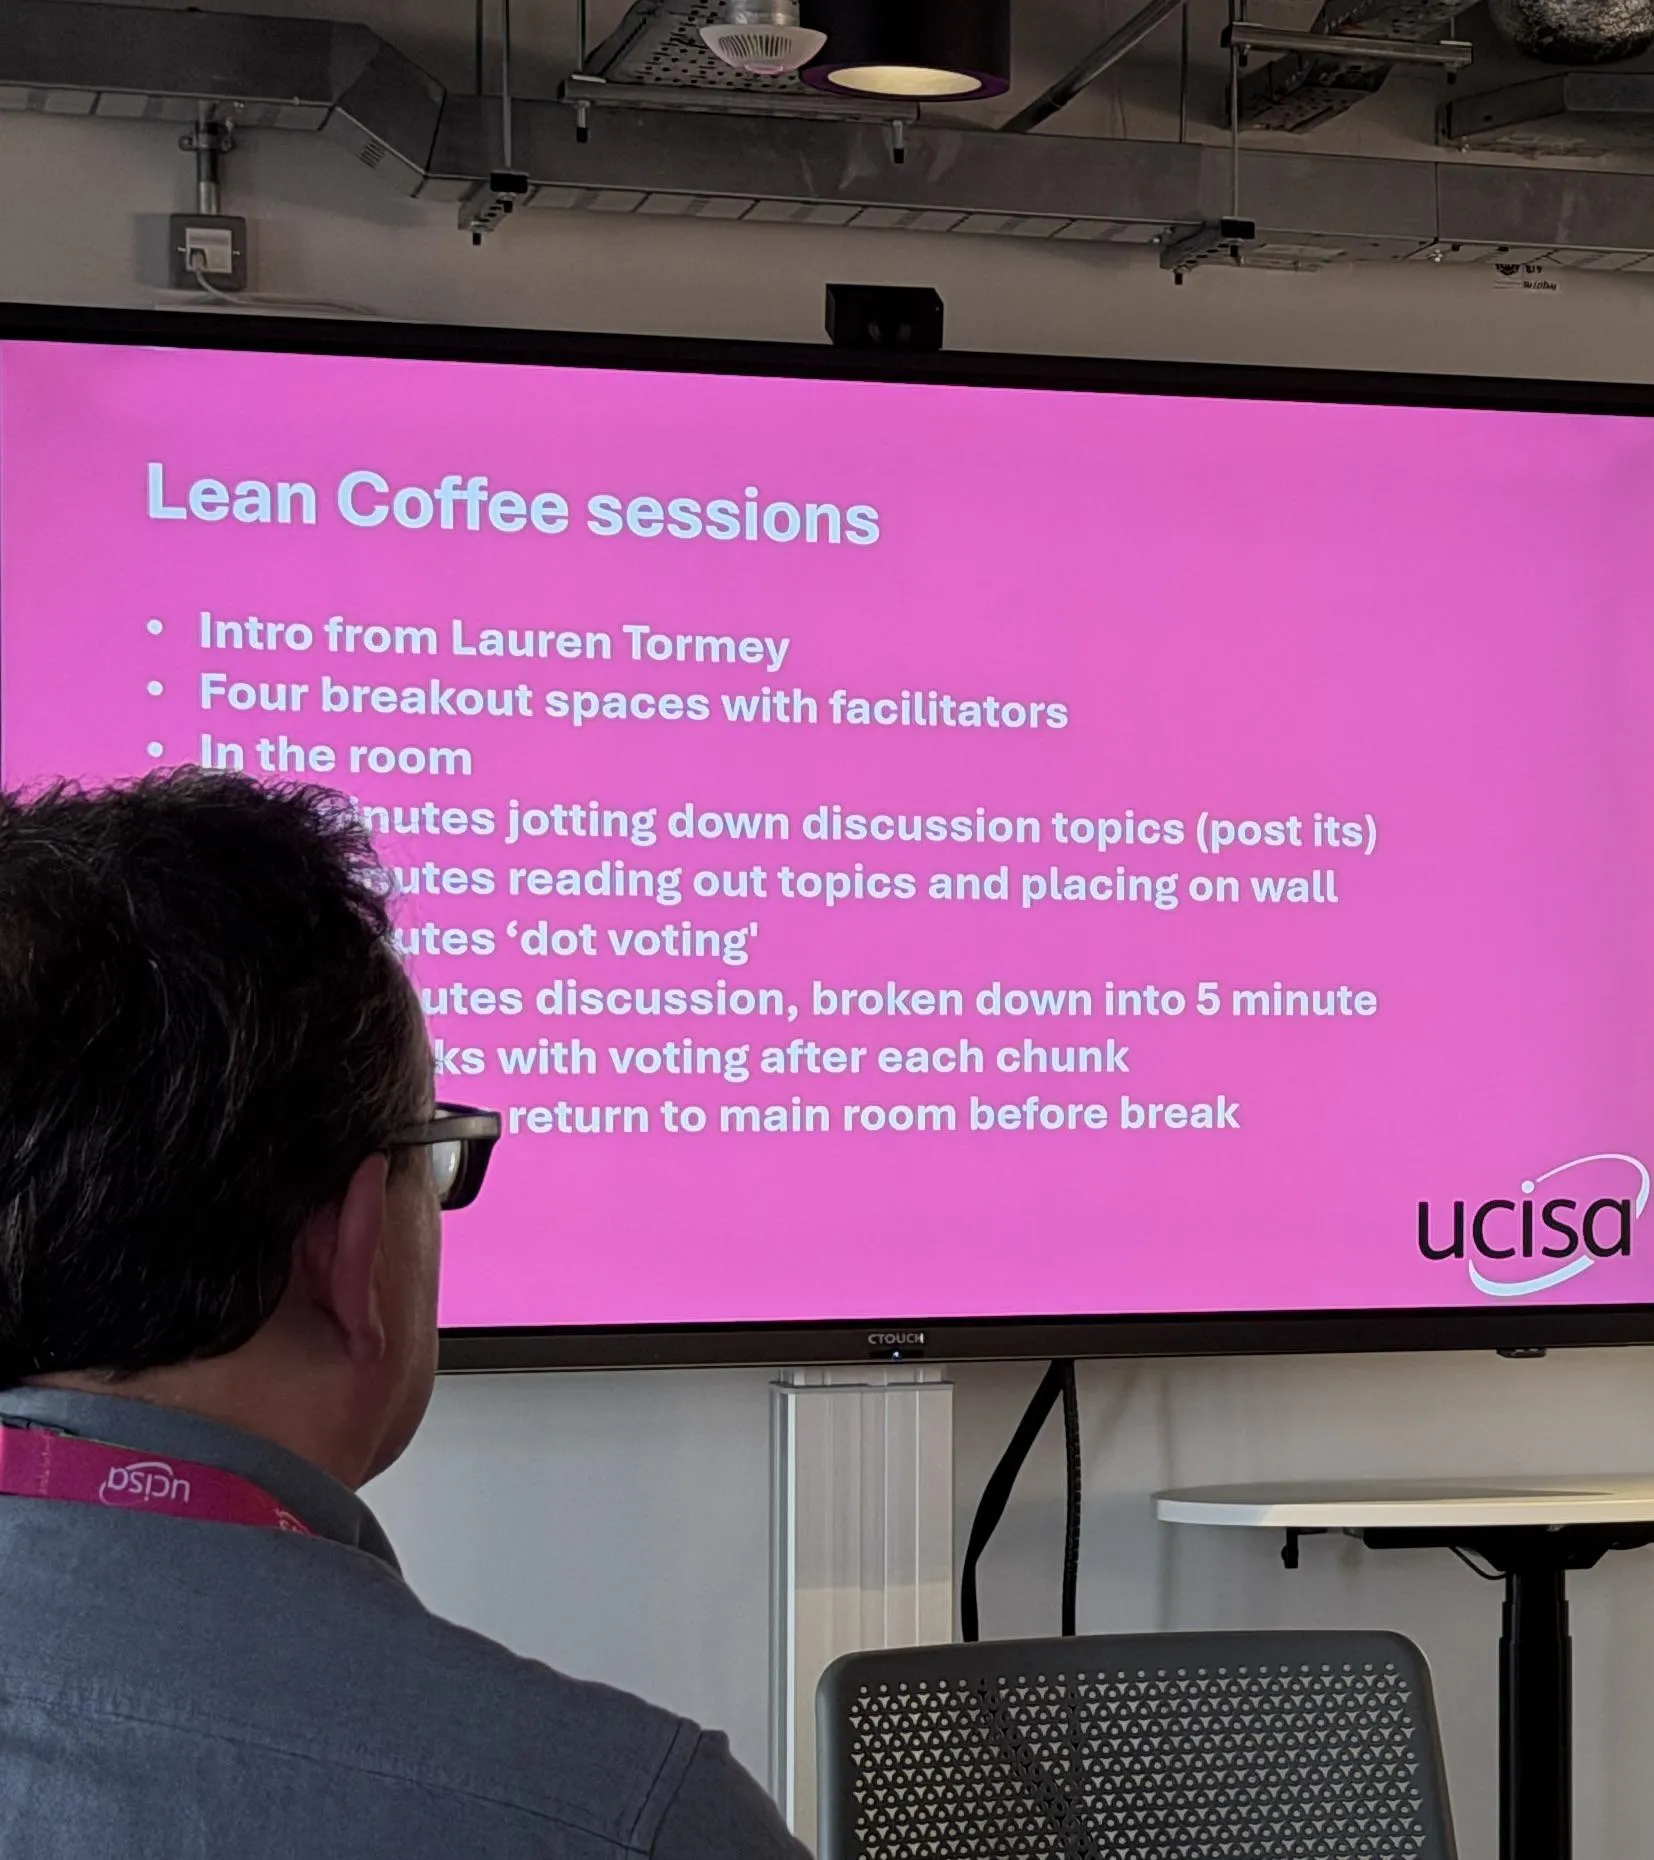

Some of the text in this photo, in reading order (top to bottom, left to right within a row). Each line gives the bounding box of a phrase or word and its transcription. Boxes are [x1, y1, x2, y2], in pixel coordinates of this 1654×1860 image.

[149, 463, 879, 544] Lean Coffee sessions
[201, 612, 789, 672] Intro from Lauren Tormey
[202, 673, 1068, 728] Four breakout spaces with facilitators
[201, 734, 471, 775] In the room
[505, 800, 656, 846] jotting
[668, 803, 788, 839] down
[803, 805, 1040, 842] discussion
[1052, 810, 1184, 852] topics
[1197, 812, 1302, 853] (post
[1314, 813, 1376, 855] its)
[394, 860, 1338, 910] utes reading out topics and placing on wall
[391, 923, 495, 955] utes
[418, 979, 1376, 1021] utes discussion, broken down into 5 minute
[497, 1038, 596, 1074] with
[609, 1038, 749, 1082] voting
[761, 1039, 867, 1073] after
[878, 1039, 983, 1072] each
[997, 1039, 1129, 1072] chunk
[510, 1095, 1240, 1133] return to main room before break
[1418, 1179, 1631, 1260] ucisa
[868, 1332, 925, 1345] CTOUCH
[107, 1466, 191, 1503] ucisa
